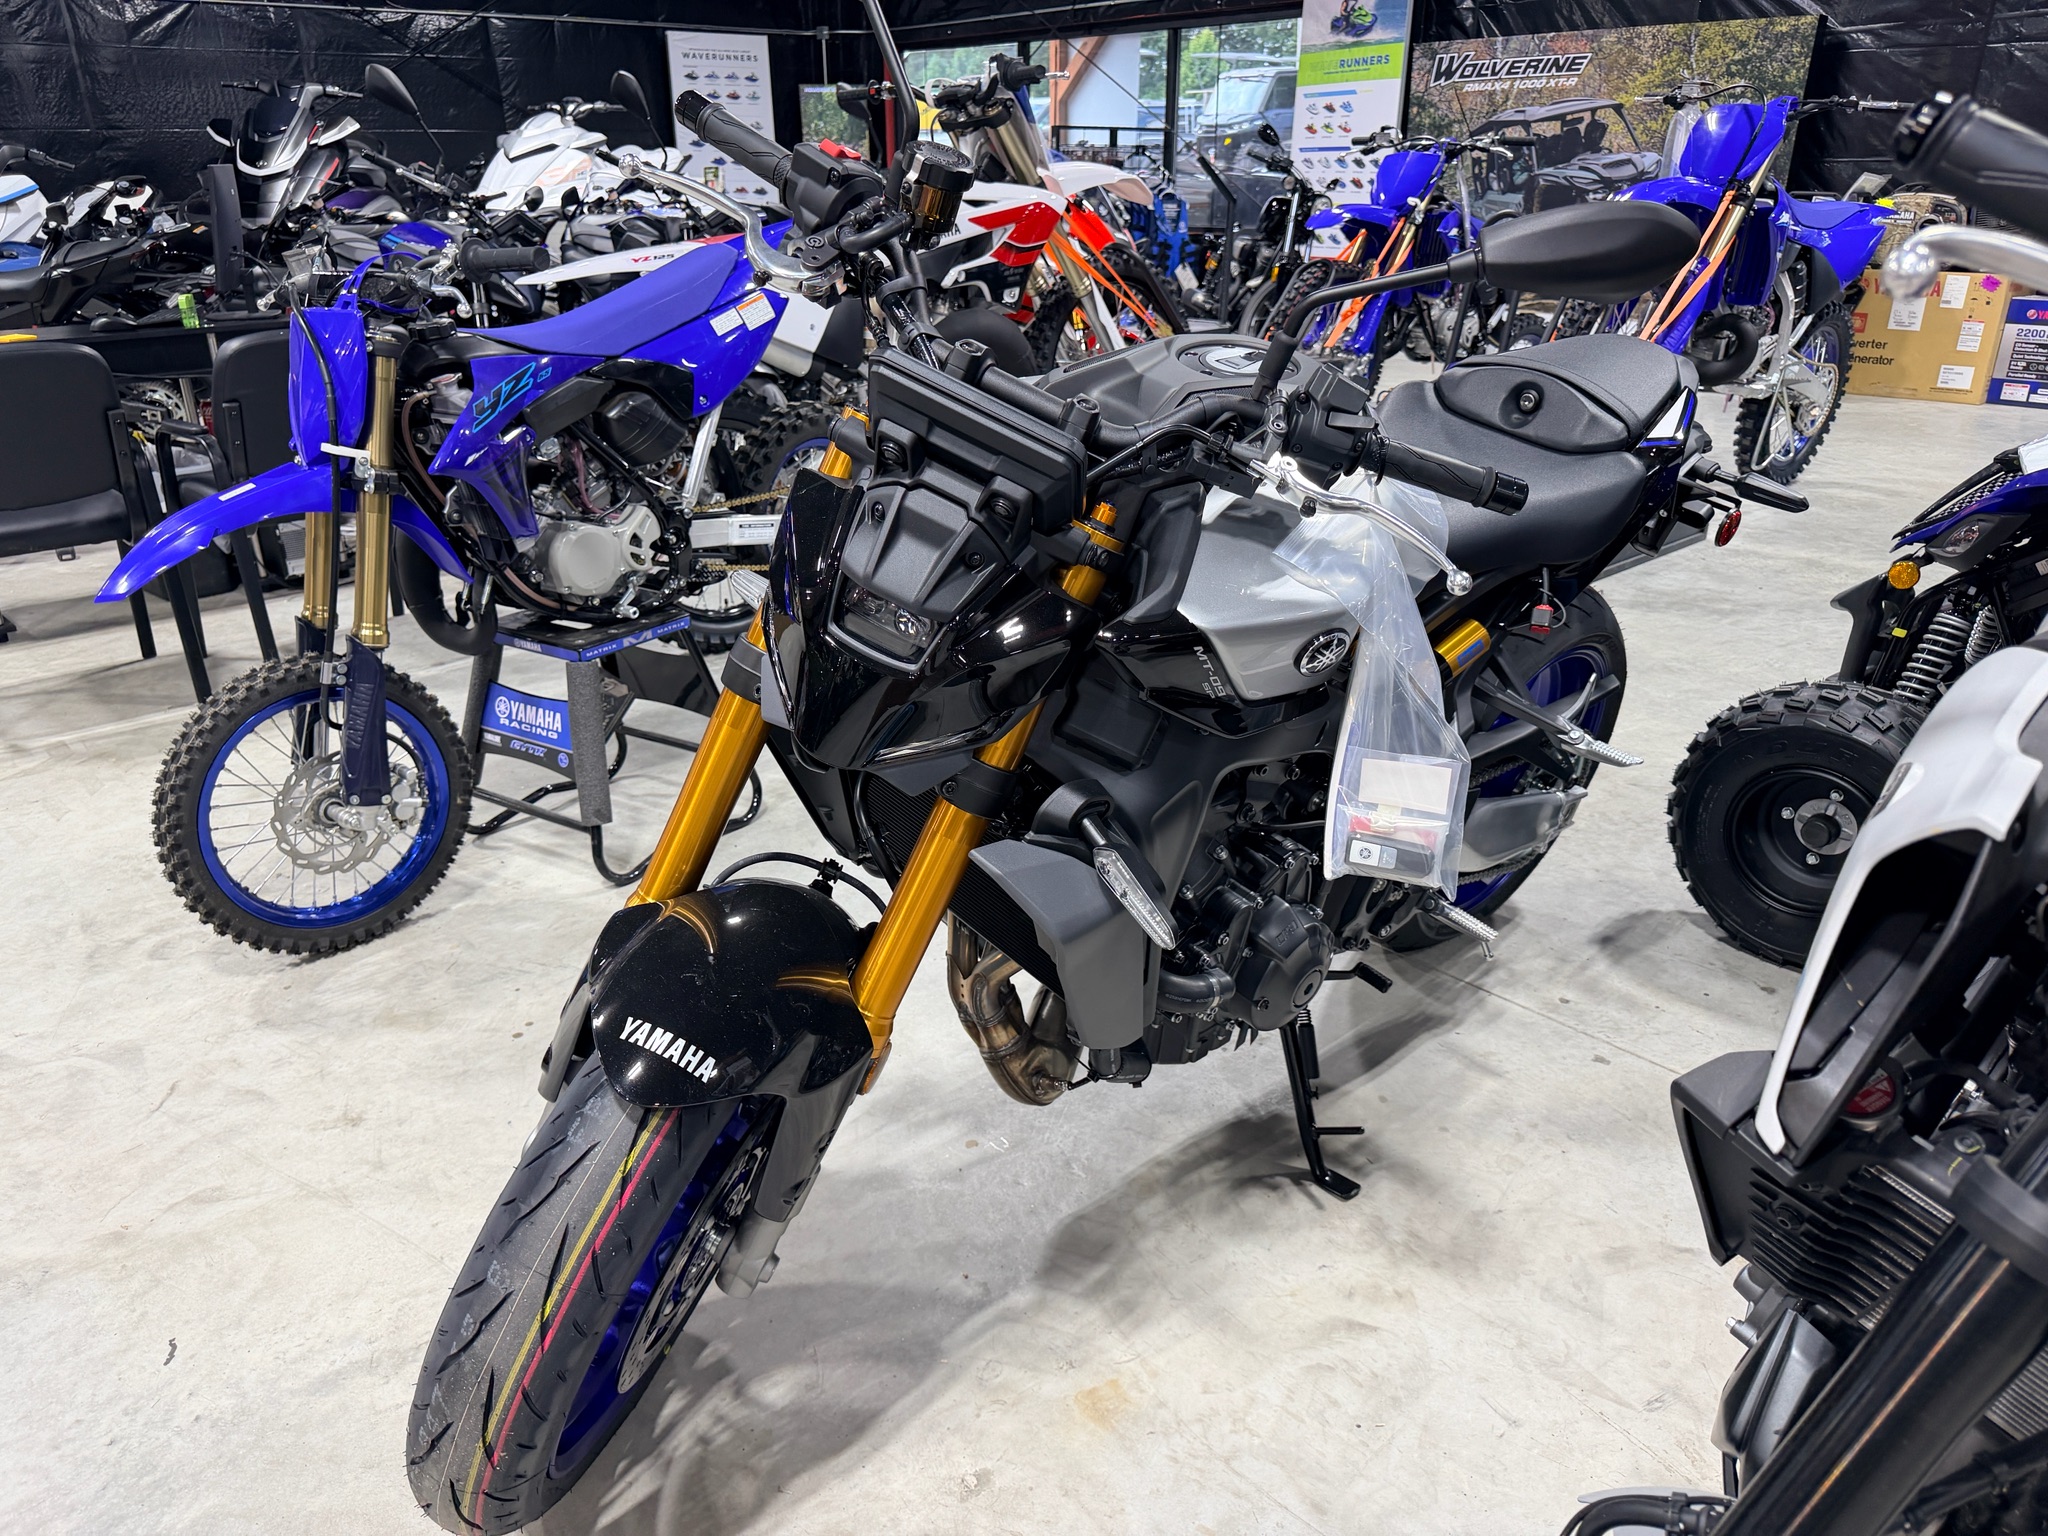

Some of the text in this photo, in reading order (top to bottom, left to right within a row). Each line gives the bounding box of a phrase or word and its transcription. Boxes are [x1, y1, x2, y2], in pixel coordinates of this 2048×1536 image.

[681, 51, 759, 63] WAVERUNNERS
[1430, 51, 1593, 87] WOLVERINE
[1463, 80, 1510, 92] RMAX4
[1512, 78, 1546, 89] 1000
[2016, 328, 2048, 339] 2200
[1852, 338, 1889, 350] verter
[1851, 353, 1895, 366] nerator
[585, 643, 618, 658] MATRIX
[656, 621, 685, 634] MATRIX
[1193, 646, 1227, 697] MT-09
[1201, 682, 1215, 699] SP
[510, 700, 563, 733] YAMAHA
[499, 717, 558, 740] RACING
[618, 1015, 717, 1084] YAMAHA
